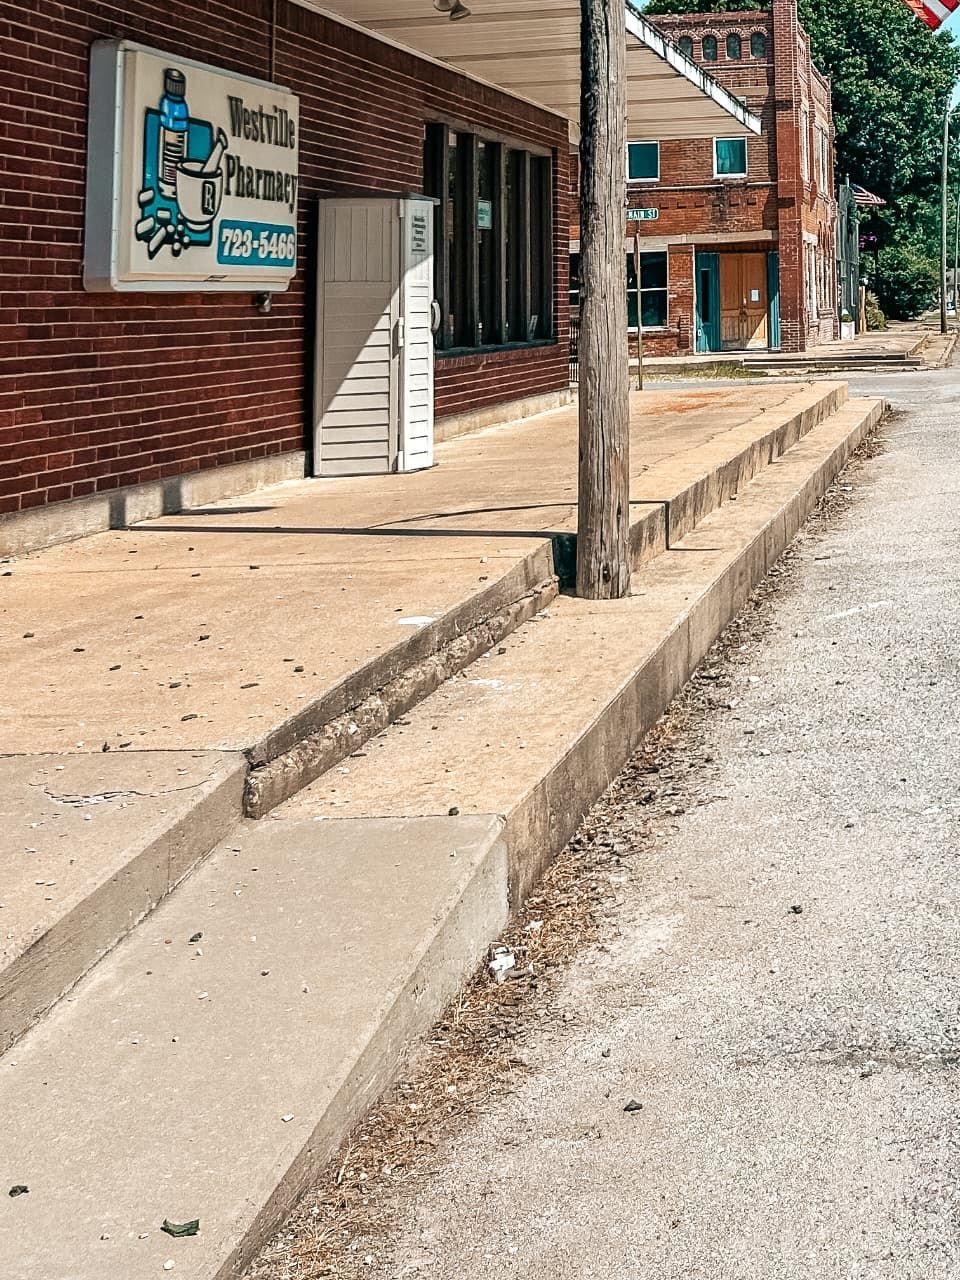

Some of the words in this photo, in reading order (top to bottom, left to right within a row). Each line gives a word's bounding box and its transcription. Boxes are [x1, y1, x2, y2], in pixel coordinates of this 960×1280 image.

[227, 94, 296, 150] Westville
[224, 152, 299, 214] Pharmacy
[221, 228, 296, 260] 723-5466
